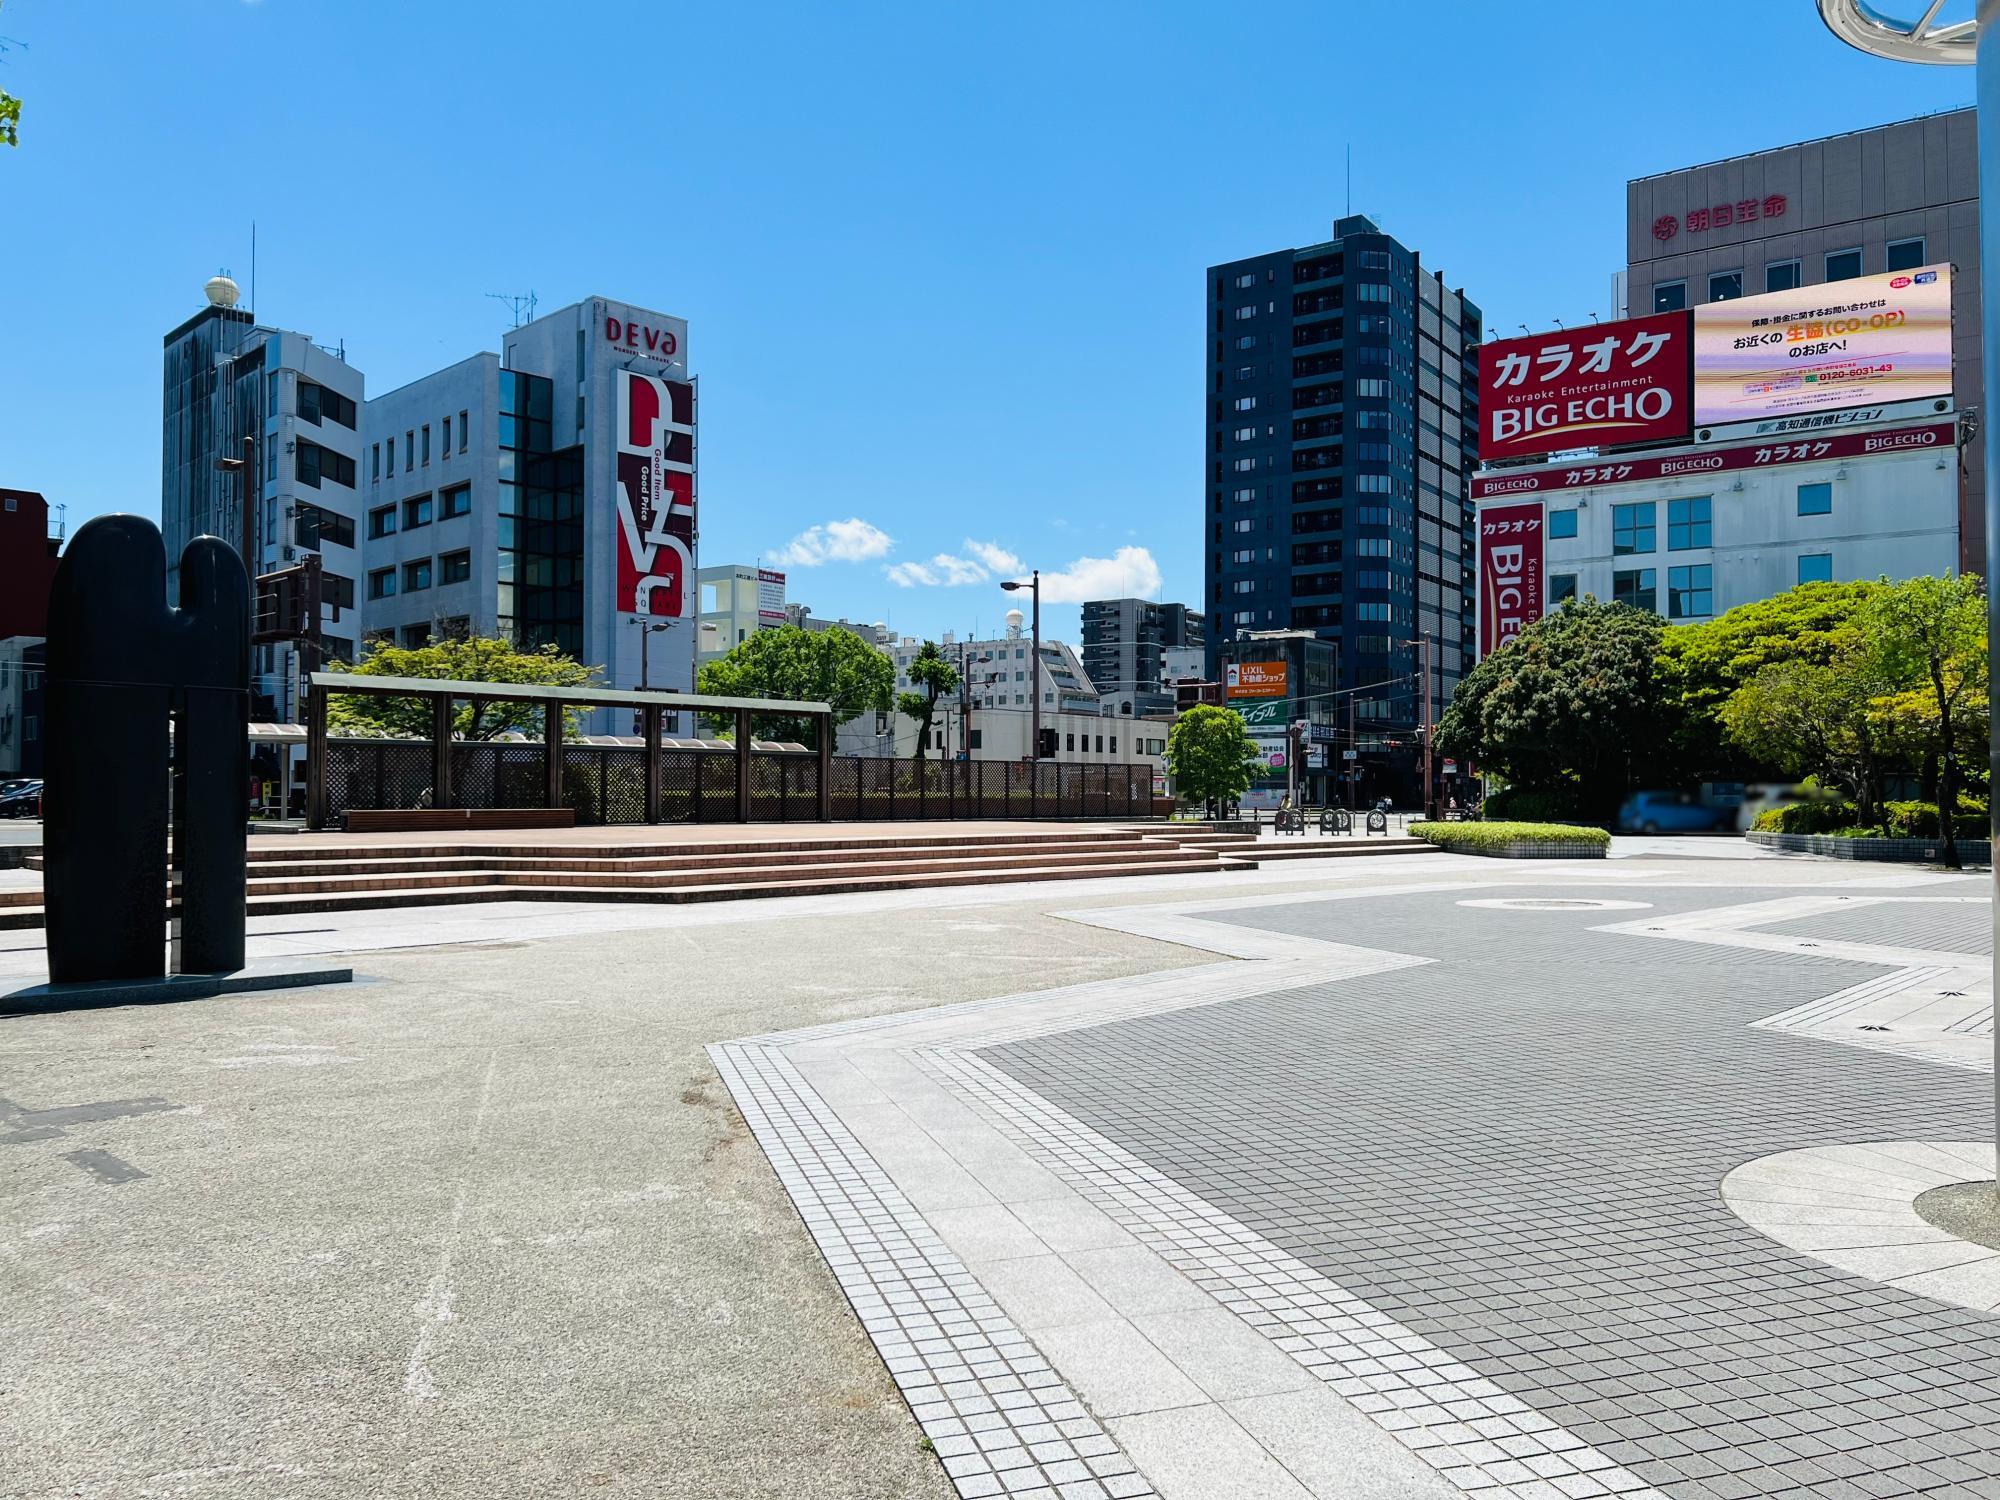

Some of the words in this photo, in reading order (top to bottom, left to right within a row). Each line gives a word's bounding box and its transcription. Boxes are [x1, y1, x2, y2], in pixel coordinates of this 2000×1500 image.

[1686, 195, 1787, 233] 朝日生命
[1733, 332, 1783, 350] お近くの
[1492, 331, 1671, 389] カラオケ
[1507, 390, 1555, 404] Karaoke
[1561, 375, 1653, 396] Entertainment
[1493, 404, 1558, 443] BIG
[1567, 387, 1673, 423] ECHO
[1755, 442, 1832, 463] カラオケ
[1865, 437, 1893, 451] BIG
[1895, 432, 1936, 445] ECHO
[1565, 465, 1633, 485] カラオケ
[1661, 461, 1685, 475] BIG
[1687, 456, 1723, 469] ECHO
[641, 466, 650, 494] Good
[1484, 481, 1506, 494] BIG
[1507, 478, 1539, 489] ECHO
[641, 496, 650, 522] Price
[1483, 519, 1541, 536] カラオケ
[1490, 544, 1524, 610] BIG
[1527, 558, 1538, 605] Karaoke
[1241, 666, 1265, 674] LIXIL
